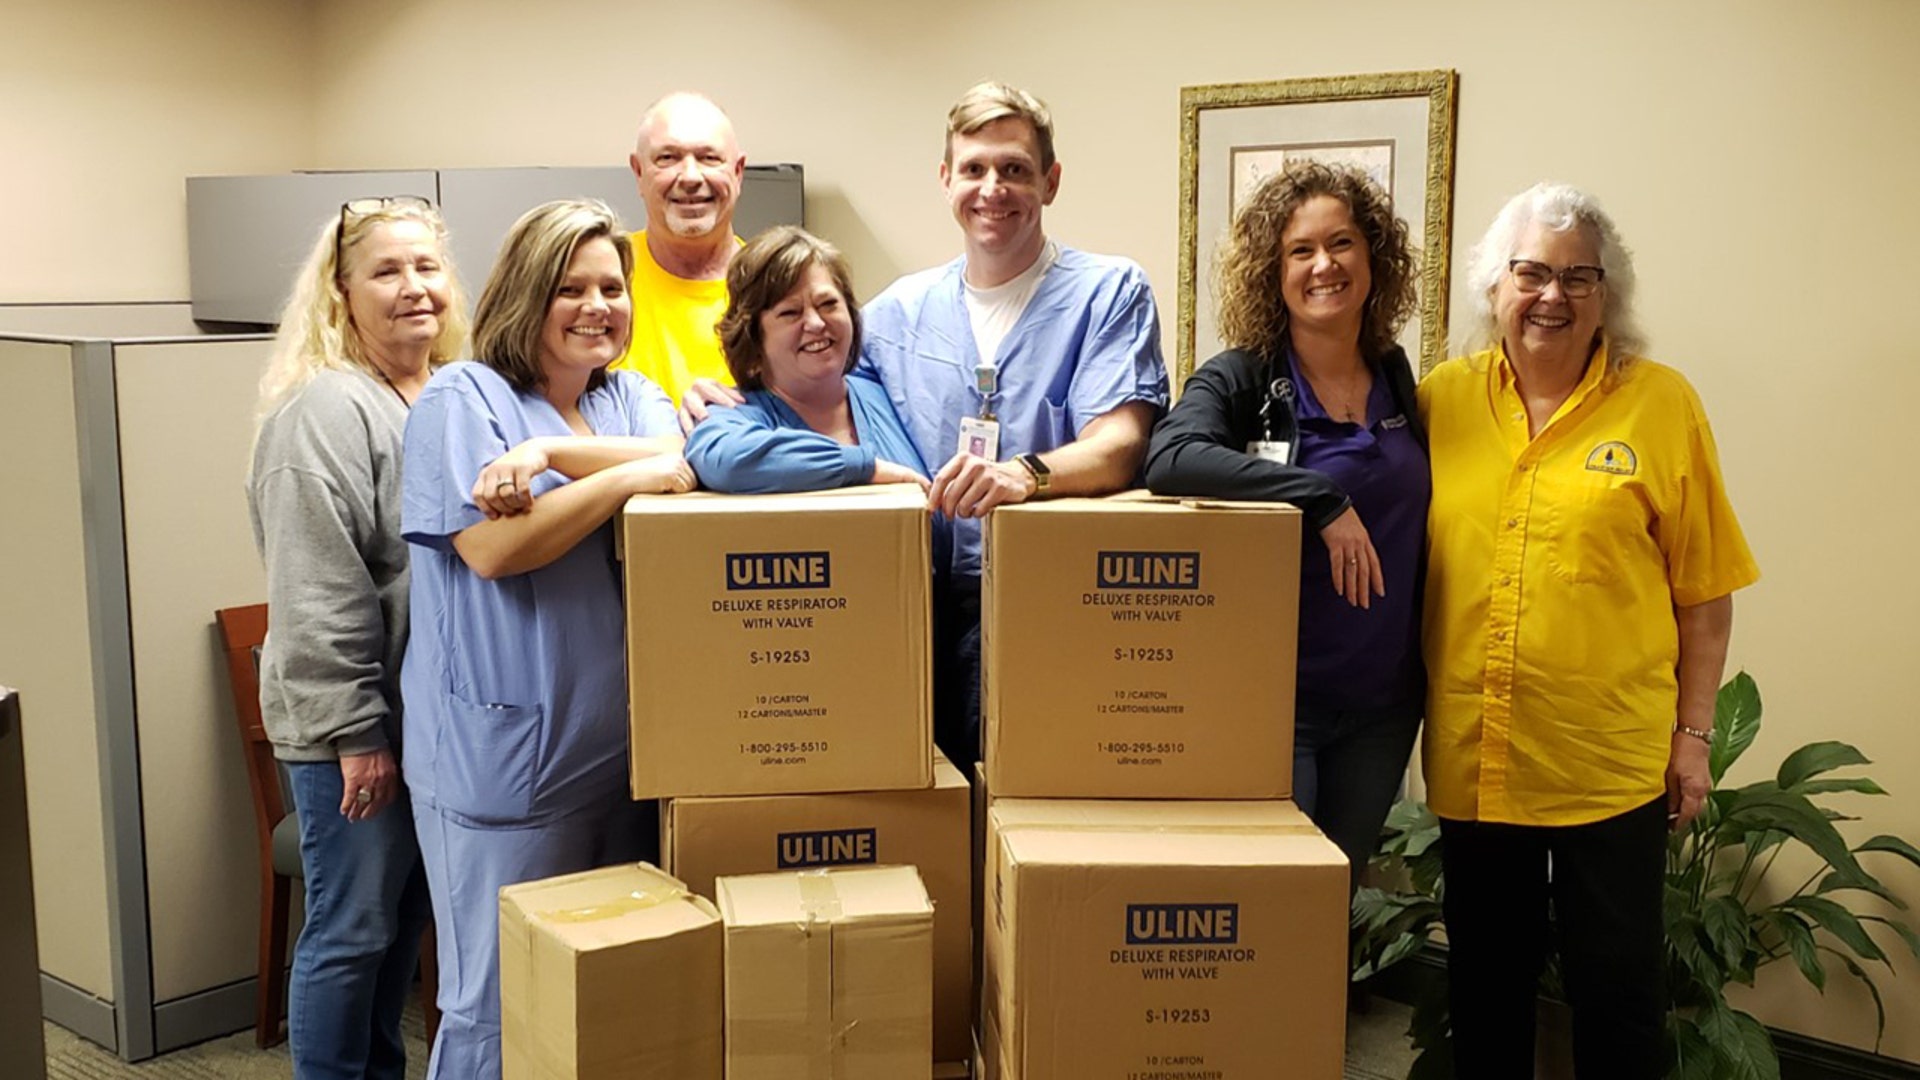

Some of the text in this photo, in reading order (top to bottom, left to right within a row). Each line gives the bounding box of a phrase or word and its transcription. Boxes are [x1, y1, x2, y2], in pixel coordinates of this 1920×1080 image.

[731, 556, 825, 585] ULINE
[1102, 556, 1195, 584] ULINE
[712, 597, 847, 612] DELUXE RESPIRATOR
[1083, 593, 1215, 607] DELUXE RESPIRATOR
[1111, 610, 1182, 622] WITH VALVE
[742, 617, 814, 629] WITH VALVE
[750, 651, 811, 664] S-19253
[1114, 648, 1174, 661] S-19253
[756, 696, 767, 704] 10
[1115, 691, 1126, 699] 10
[738, 708, 827, 719] 12 CARTONS/MASTER
[1097, 705, 1107, 713] 12
[740, 742, 828, 753] 1-800-295-5510
[1097, 743, 1184, 753] 1-800-295-5510
[760, 757, 806, 765] uline.com
[1117, 757, 1162, 765] uline.com
[782, 833, 871, 863] ULINE
[1132, 909, 1232, 939] ULINE
[1110, 949, 1256, 963] DELUXE RESPIRATOR
[1142, 967, 1218, 979] WITH VALVE
[1145, 1009, 1210, 1023] S-19253
[1146, 1056, 1158, 1065] 10
